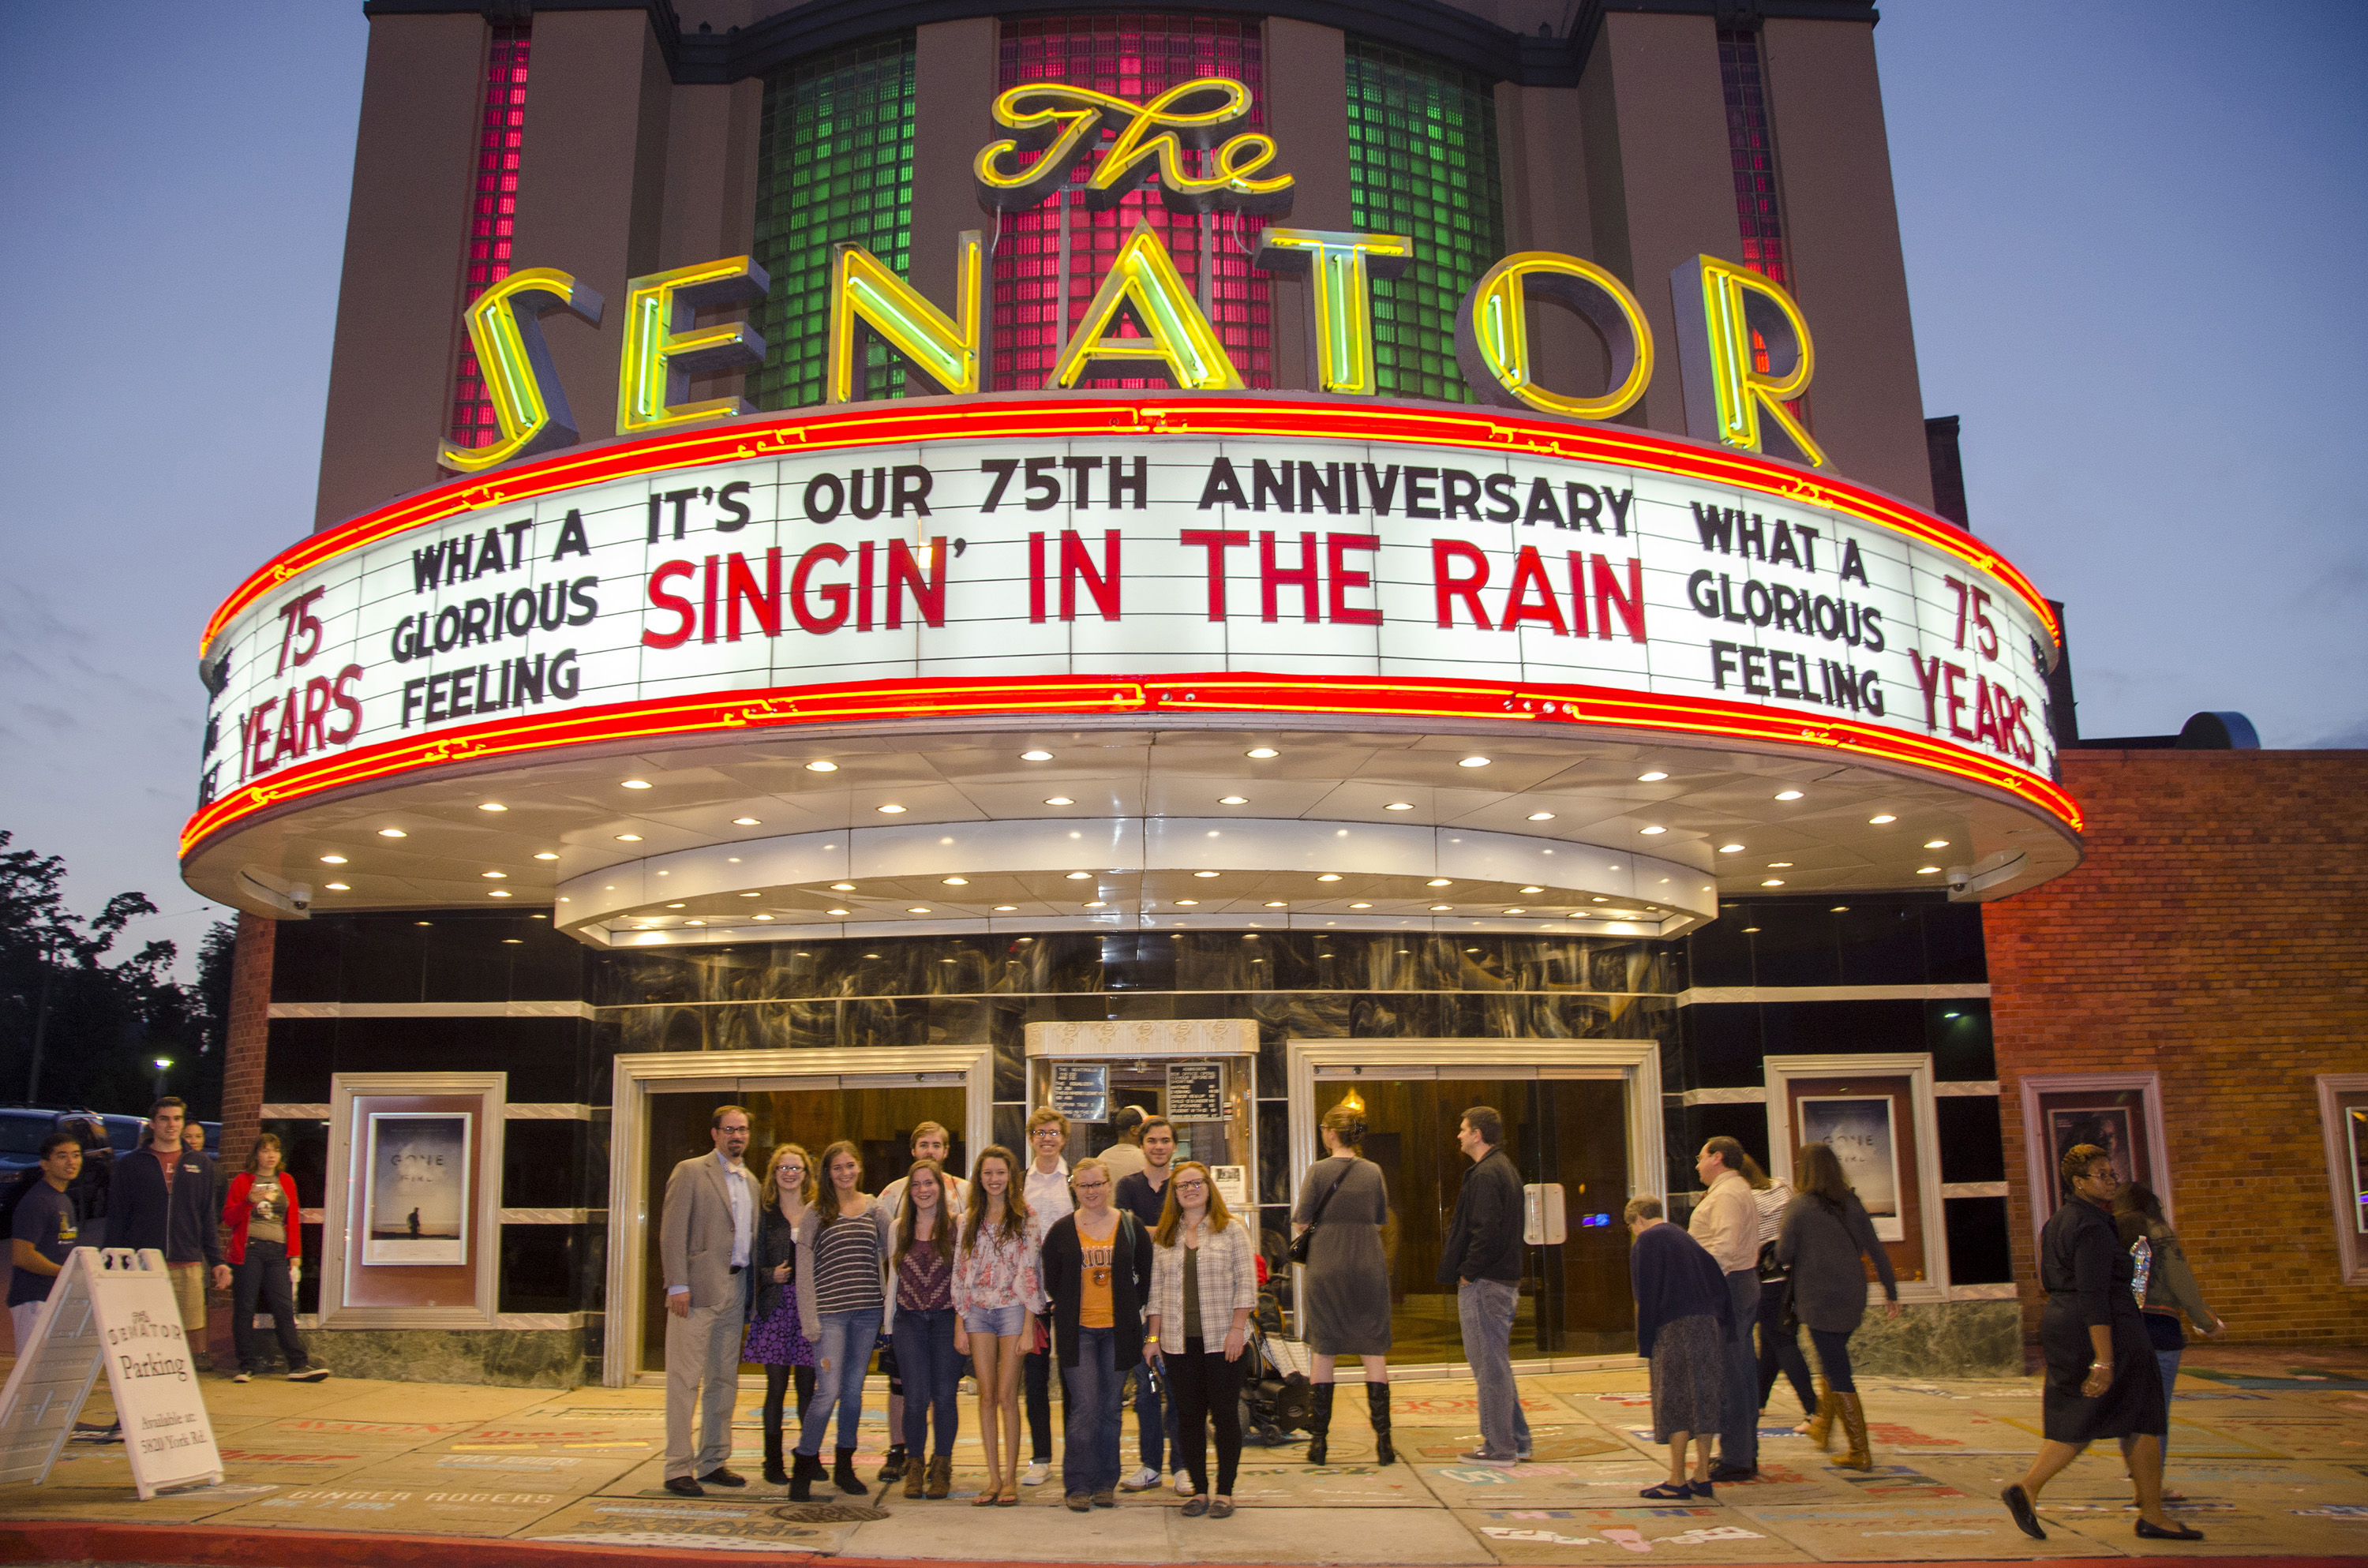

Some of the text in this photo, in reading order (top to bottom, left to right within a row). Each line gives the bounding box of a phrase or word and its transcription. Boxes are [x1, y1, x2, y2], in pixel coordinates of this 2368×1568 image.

[974, 77, 1295, 207] The
[438, 215, 1830, 473] SENATOR
[647, 455, 1633, 544] IT'S OUR 75TH ANNIVERSARY
[413, 508, 591, 595] WHAT A
[1689, 500, 1869, 588] WHAT A
[274, 584, 326, 679] 75
[392, 574, 600, 663] GLORIOUS
[640, 528, 1648, 650] SINGIN' IN THE RAIN
[1687, 568, 1886, 653] GLORIOUS
[1944, 574, 1999, 661] 75
[401, 648, 580, 730] FEELING
[1710, 638, 1885, 717] FEELING
[1908, 647, 2035, 767] YEARS
[238, 663, 364, 783] YEARS
[107, 1323, 182, 1345] SENATOR
[120, 1352, 188, 1382] Parking
[141, 1412, 182, 1430] Available
[165, 1431, 190, 1450] York
[285, 1491, 553, 1504] GINGER ROGERS
[1482, 1508, 1714, 1520] THE TUNE
